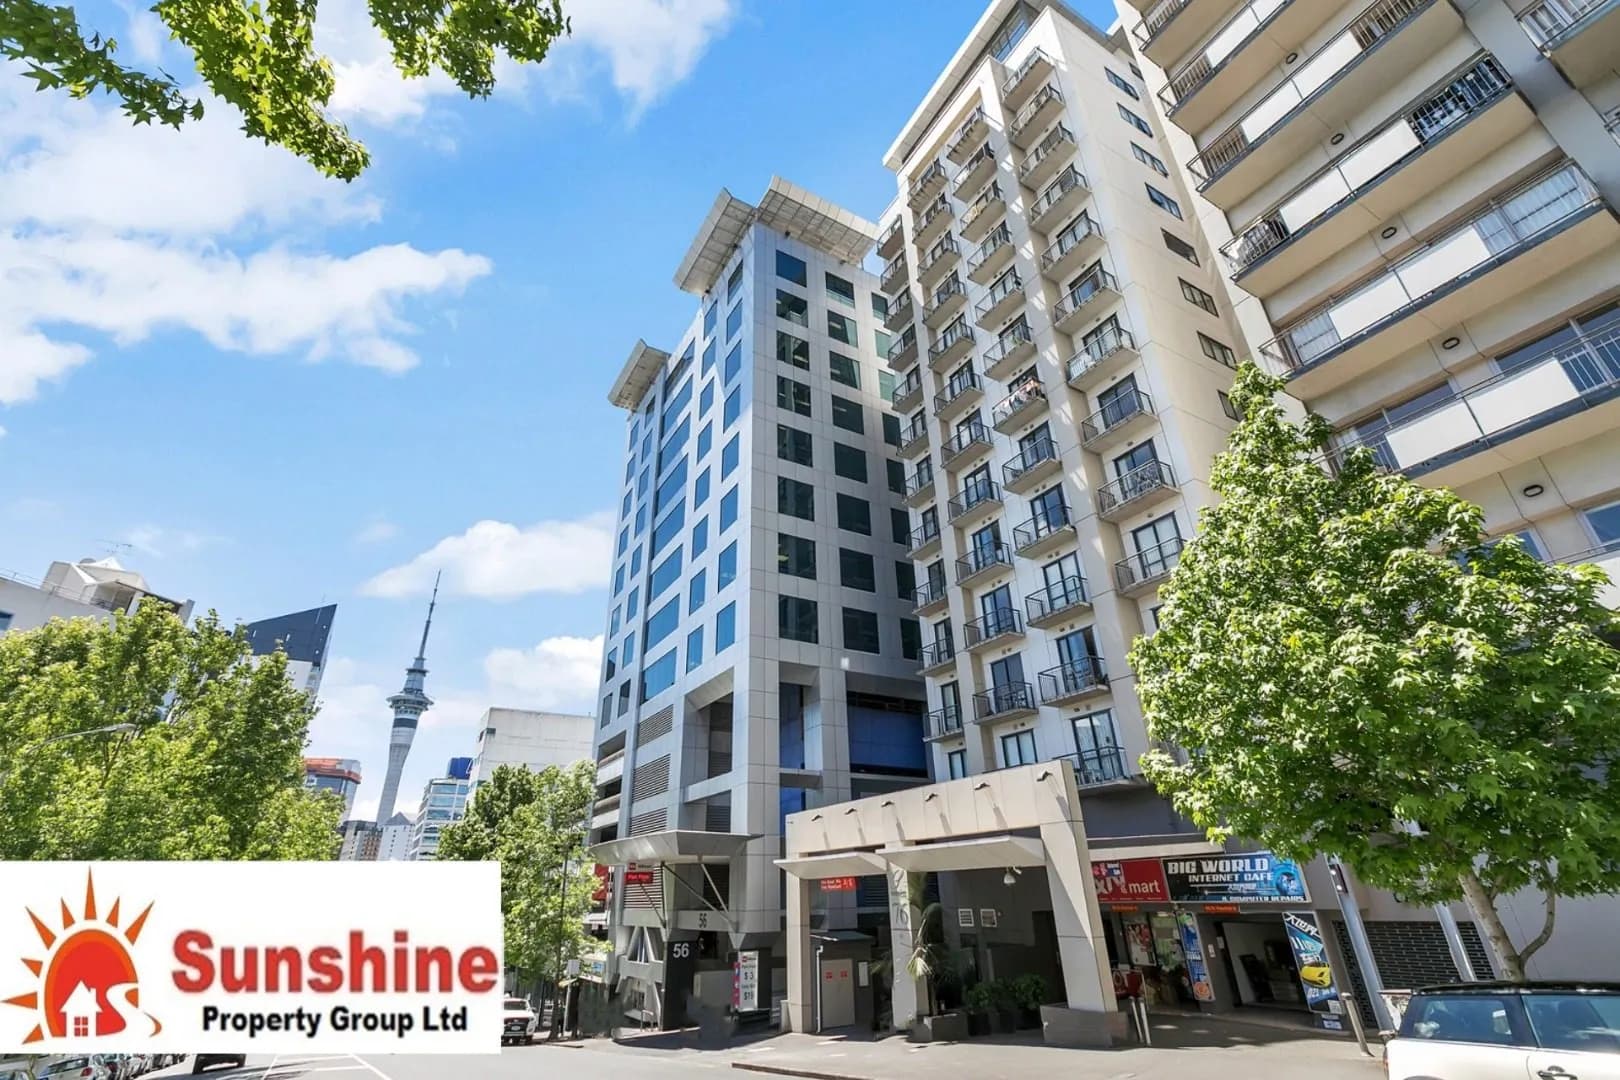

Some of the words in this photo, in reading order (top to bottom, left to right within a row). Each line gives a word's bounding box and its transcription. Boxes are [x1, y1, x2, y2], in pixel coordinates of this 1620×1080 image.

[1168, 861, 1197, 874] BIG
[1200, 858, 1269, 873] WORLD
[1188, 873, 1240, 883] INTERNET
[1243, 872, 1275, 882] CAFE
[1128, 879, 1161, 894] mart
[699, 912, 708, 929] 56
[673, 943, 690, 958] 56
